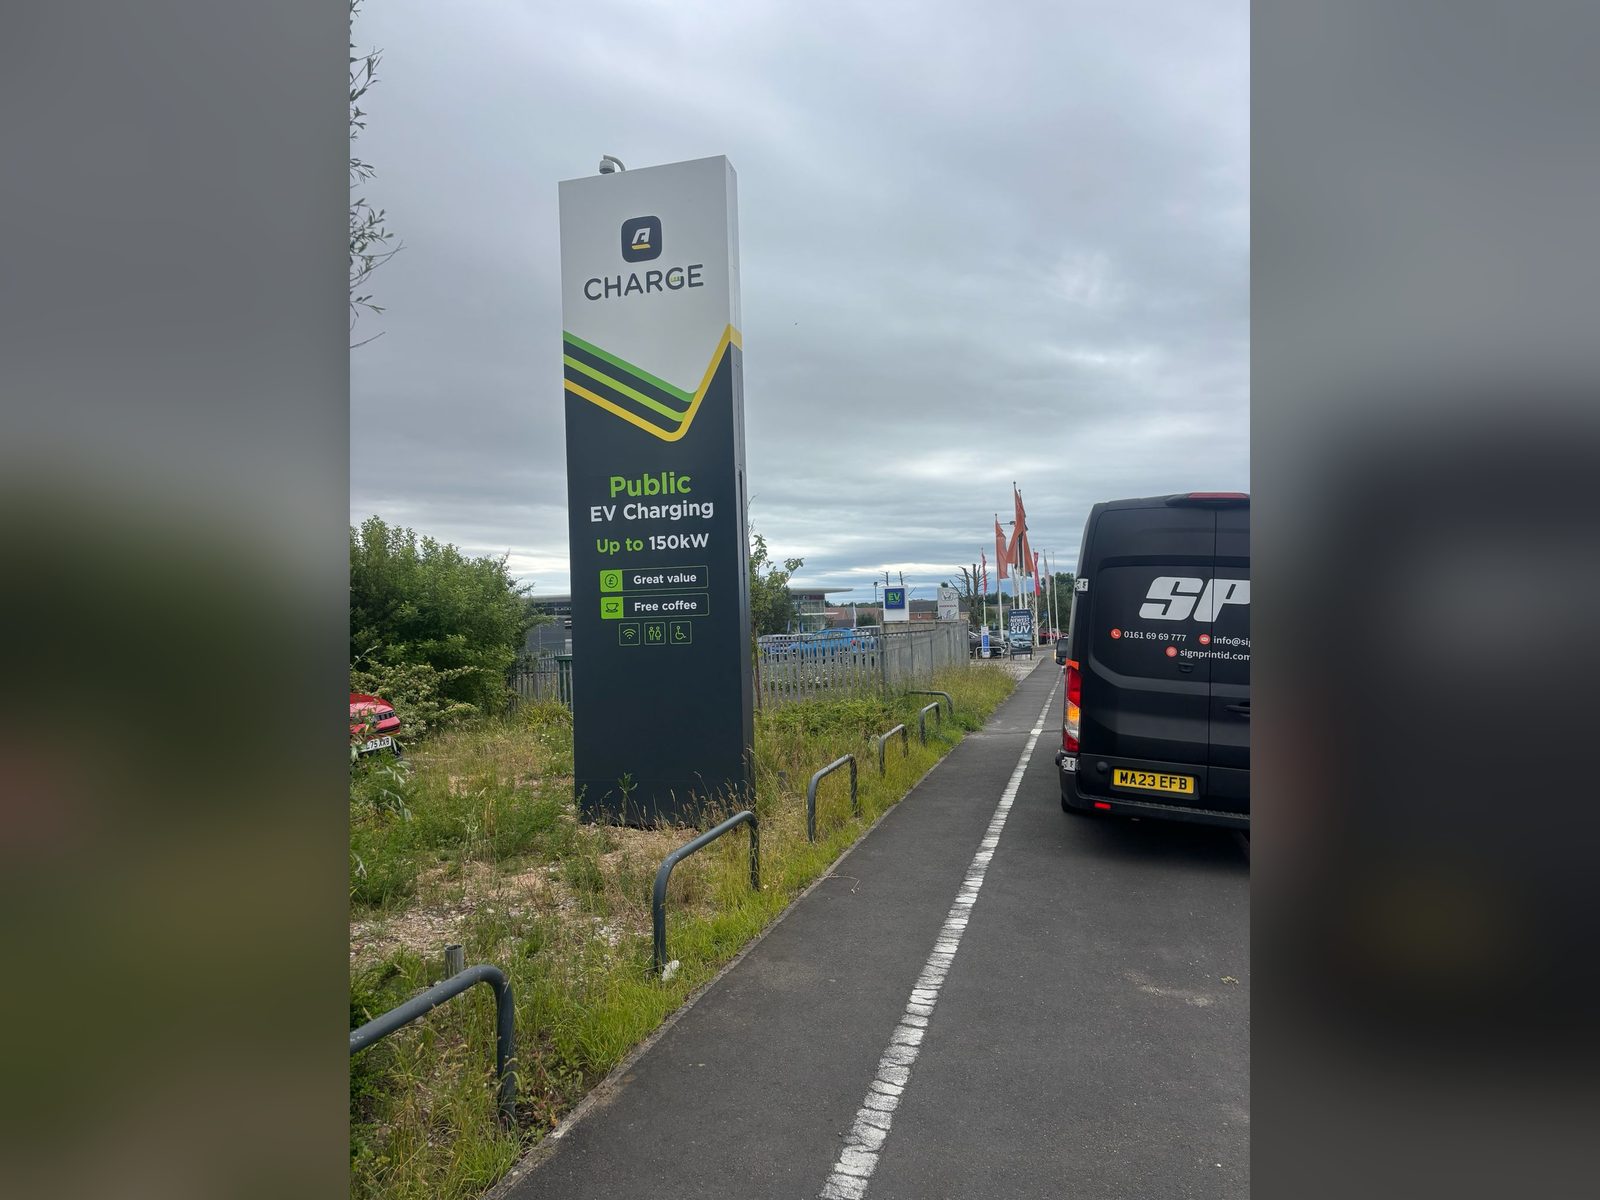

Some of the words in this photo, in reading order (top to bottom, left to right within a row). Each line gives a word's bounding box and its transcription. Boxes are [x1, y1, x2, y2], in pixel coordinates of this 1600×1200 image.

[584, 264, 704, 300] CHARGE
[610, 471, 691, 498] Public
[590, 505, 616, 522] EV
[623, 500, 714, 520] Charging
[596, 538, 620, 555] Up
[626, 537, 643, 551] to
[649, 533, 709, 550] 150kW
[633, 574, 664, 584] Great
[667, 573, 697, 583] value
[887, 592, 900, 601] EV
[634, 602, 659, 611] Free
[662, 600, 697, 610] coffee
[1010, 626, 1030, 634] SUV
[1124, 631, 1144, 639] 0161
[1146, 632, 1157, 640] 69
[1158, 633, 1169, 641] 69
[1171, 633, 1187, 642] 777
[1120, 771, 1156, 787] MA23
[1160, 775, 1187, 790] EFB
